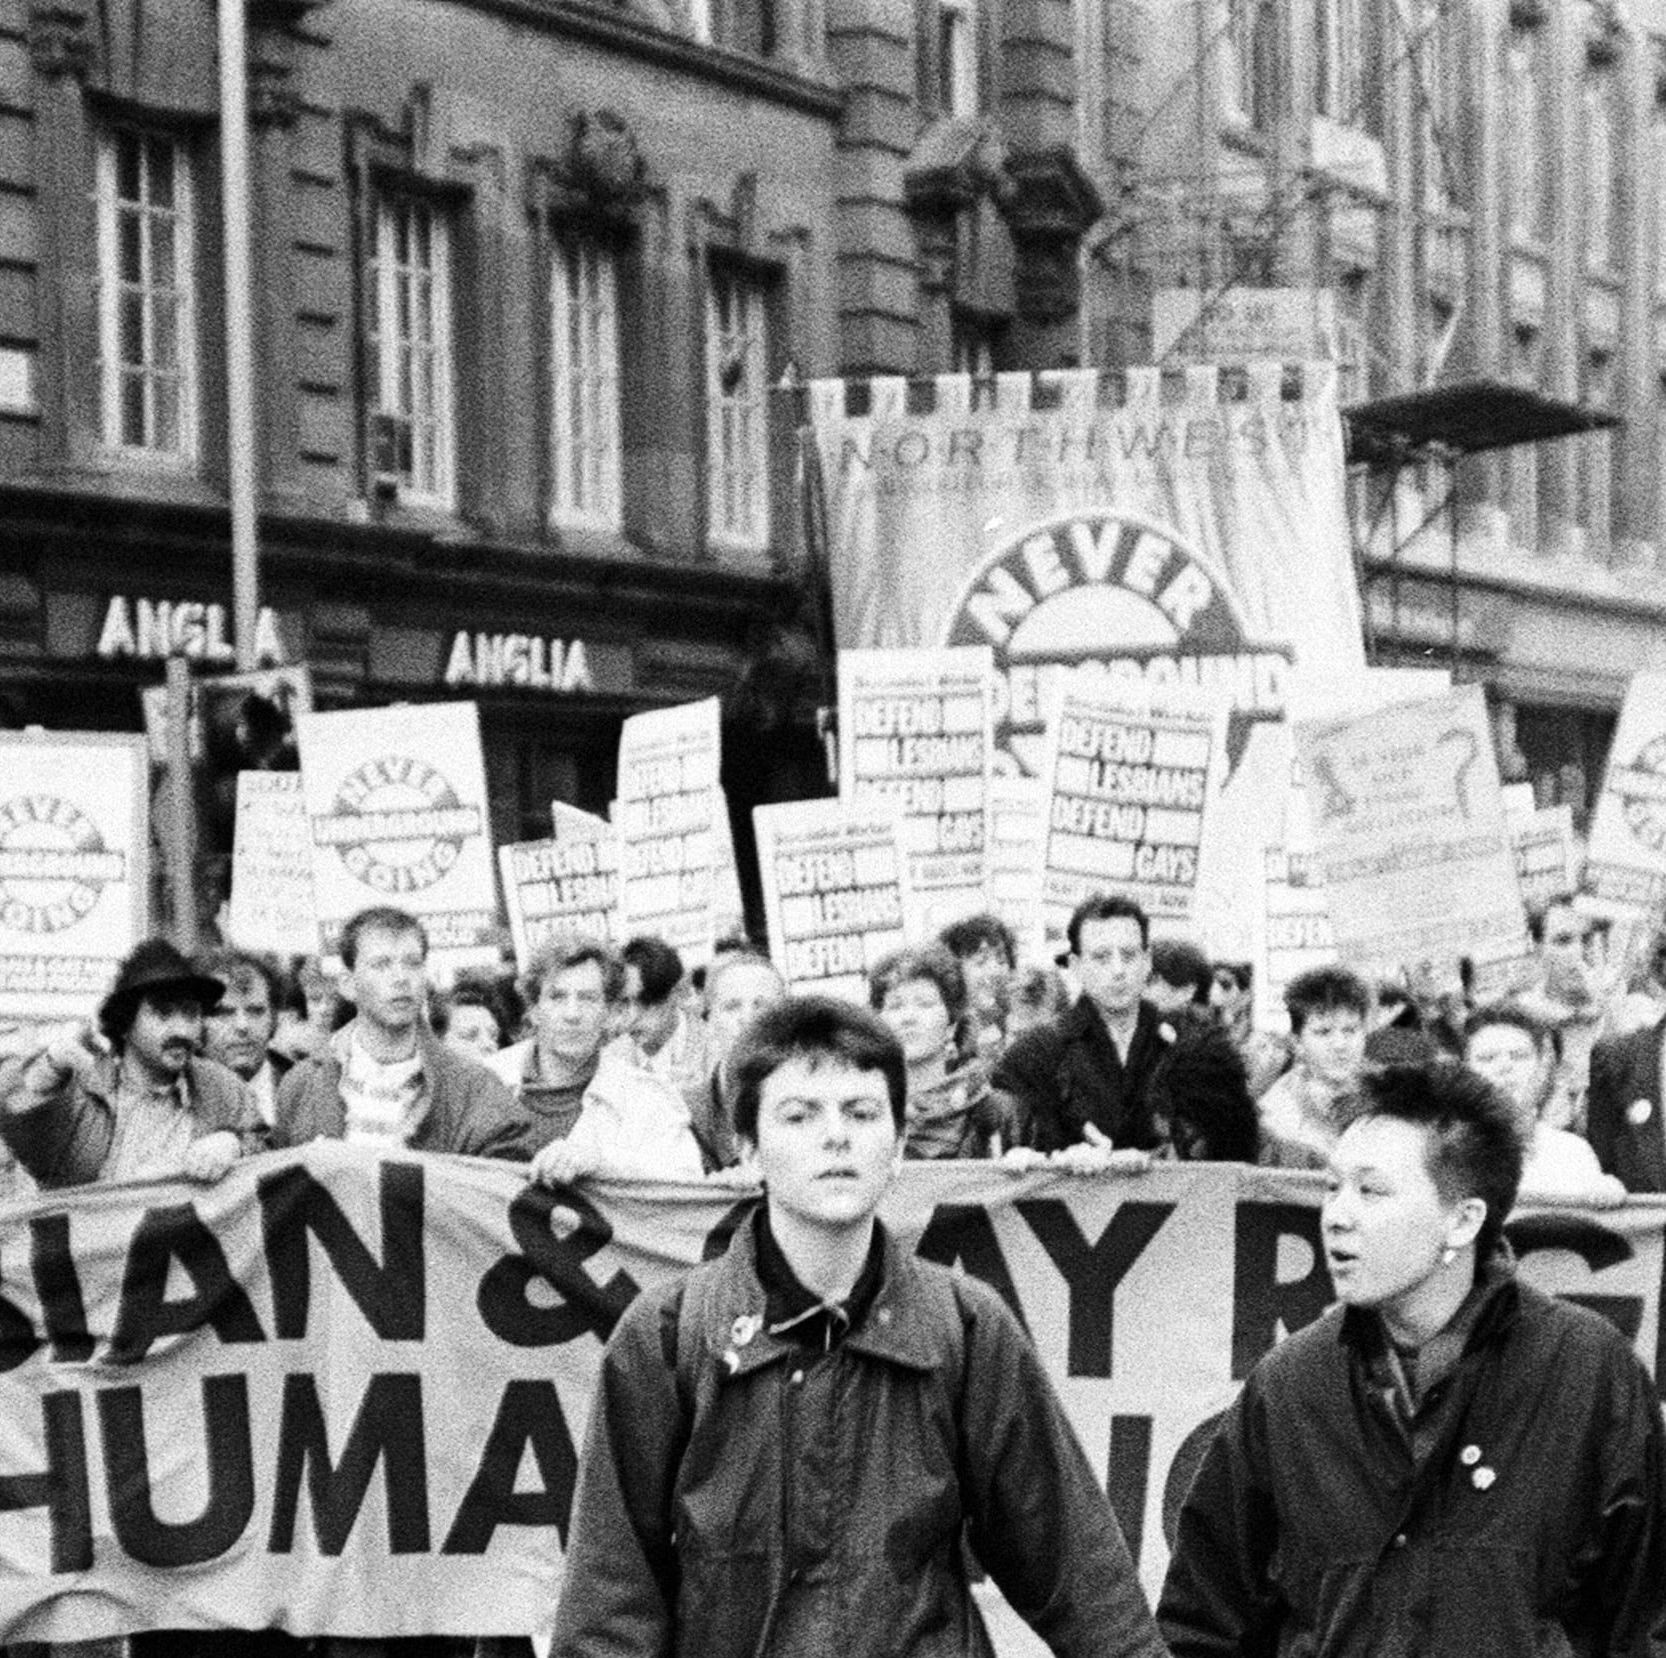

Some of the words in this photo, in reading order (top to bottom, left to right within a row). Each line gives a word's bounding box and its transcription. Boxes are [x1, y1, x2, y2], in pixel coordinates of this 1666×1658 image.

[966, 518, 1213, 646] NEVER
[97, 595, 285, 664] ANGLA
[445, 630, 594, 692] ANGLIA
[1057, 718, 1153, 768] DEFEND
[1089, 758, 1207, 808] LESBIANS
[1050, 794, 1147, 845] DEFEND
[1133, 842, 1199, 886] GAYS
[477, 1174, 642, 1348] &
